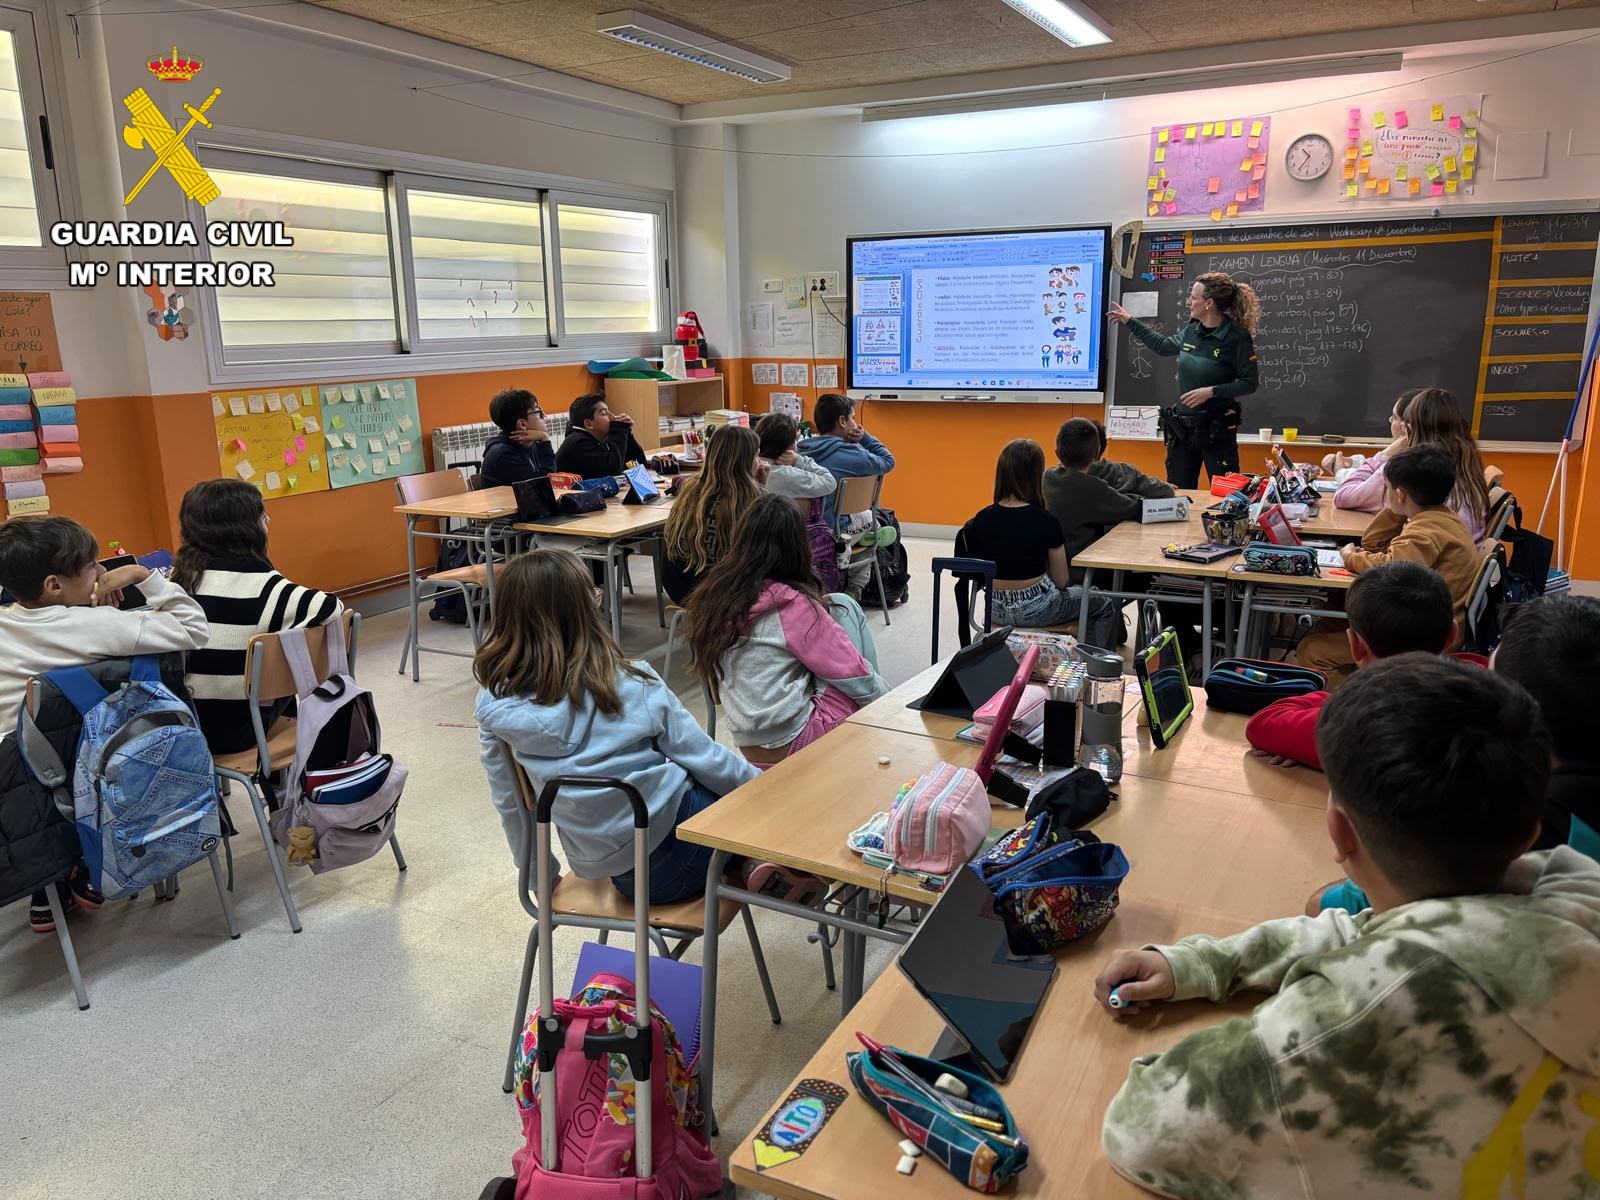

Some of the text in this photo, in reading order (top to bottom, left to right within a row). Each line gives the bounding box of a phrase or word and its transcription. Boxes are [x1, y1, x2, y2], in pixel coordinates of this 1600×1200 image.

[1208, 254, 1256, 273] EXAMEN
[1260, 252, 1301, 267] LENGUA
[4, 340, 43, 351] CORREO
